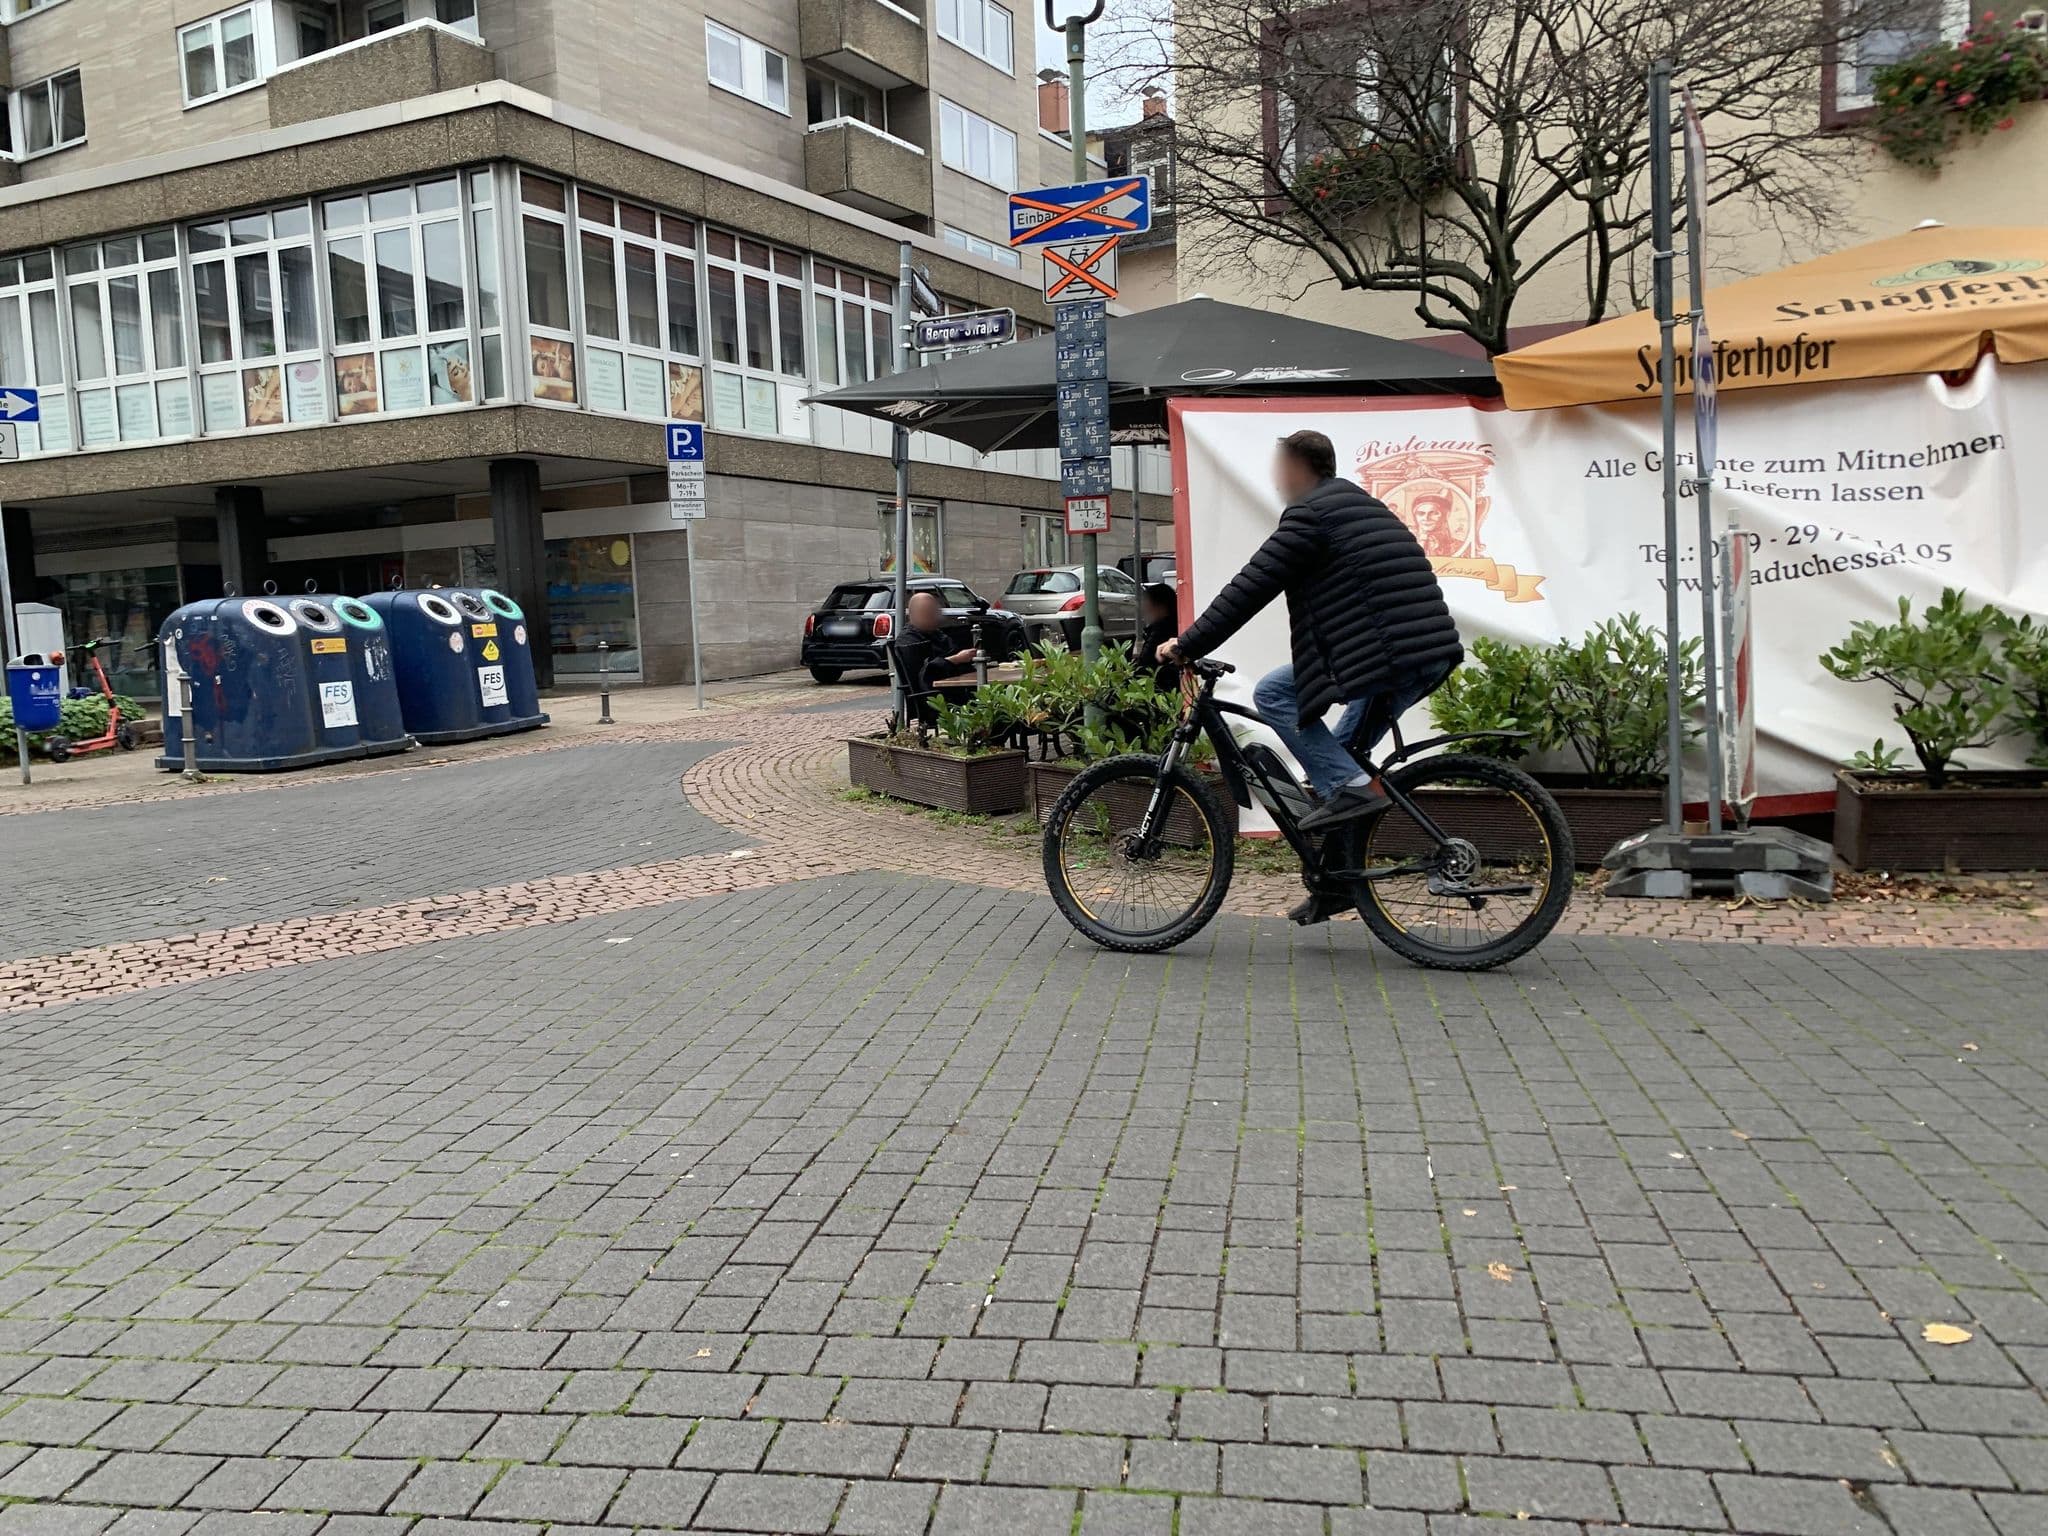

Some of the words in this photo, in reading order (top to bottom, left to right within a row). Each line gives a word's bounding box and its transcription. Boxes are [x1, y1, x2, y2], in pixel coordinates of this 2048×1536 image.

[672, 428, 692, 456] P
[1585, 458, 1636, 478] Alle
[1764, 458, 1825, 473] zum
[1836, 435, 2005, 471] Mitnehmen
[1724, 476, 1821, 501] Liefern
[1832, 483, 1924, 502] lassen
[1640, 544, 1694, 563] Te.:
[1785, 525, 1819, 546] 29
[1916, 544, 1953, 562] 05
[325, 685, 348, 698] FES
[484, 672, 501, 685] FES
